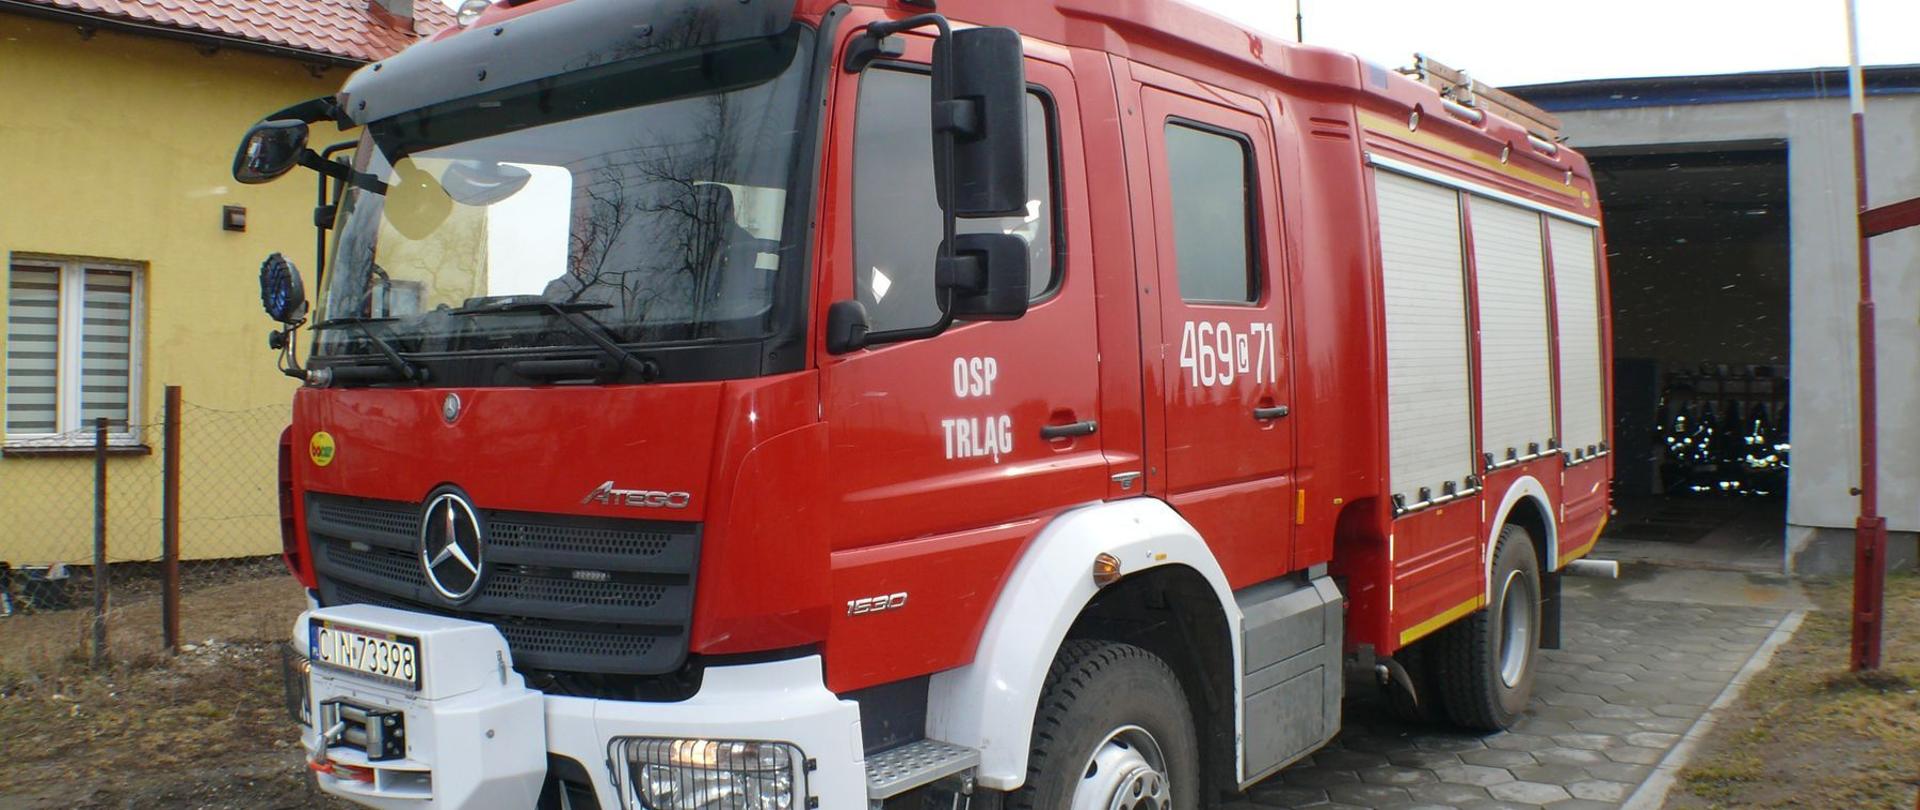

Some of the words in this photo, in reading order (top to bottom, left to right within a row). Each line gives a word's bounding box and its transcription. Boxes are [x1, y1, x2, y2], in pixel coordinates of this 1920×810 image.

[953, 356, 998, 398] OSP
[1180, 320, 1235, 387] 469
[1250, 322, 1275, 384] 71
[941, 414, 1013, 464] TRLĄG
[847, 591, 908, 616] 1530
[319, 629, 353, 667] CIN
[356, 635, 413, 680] 73398
